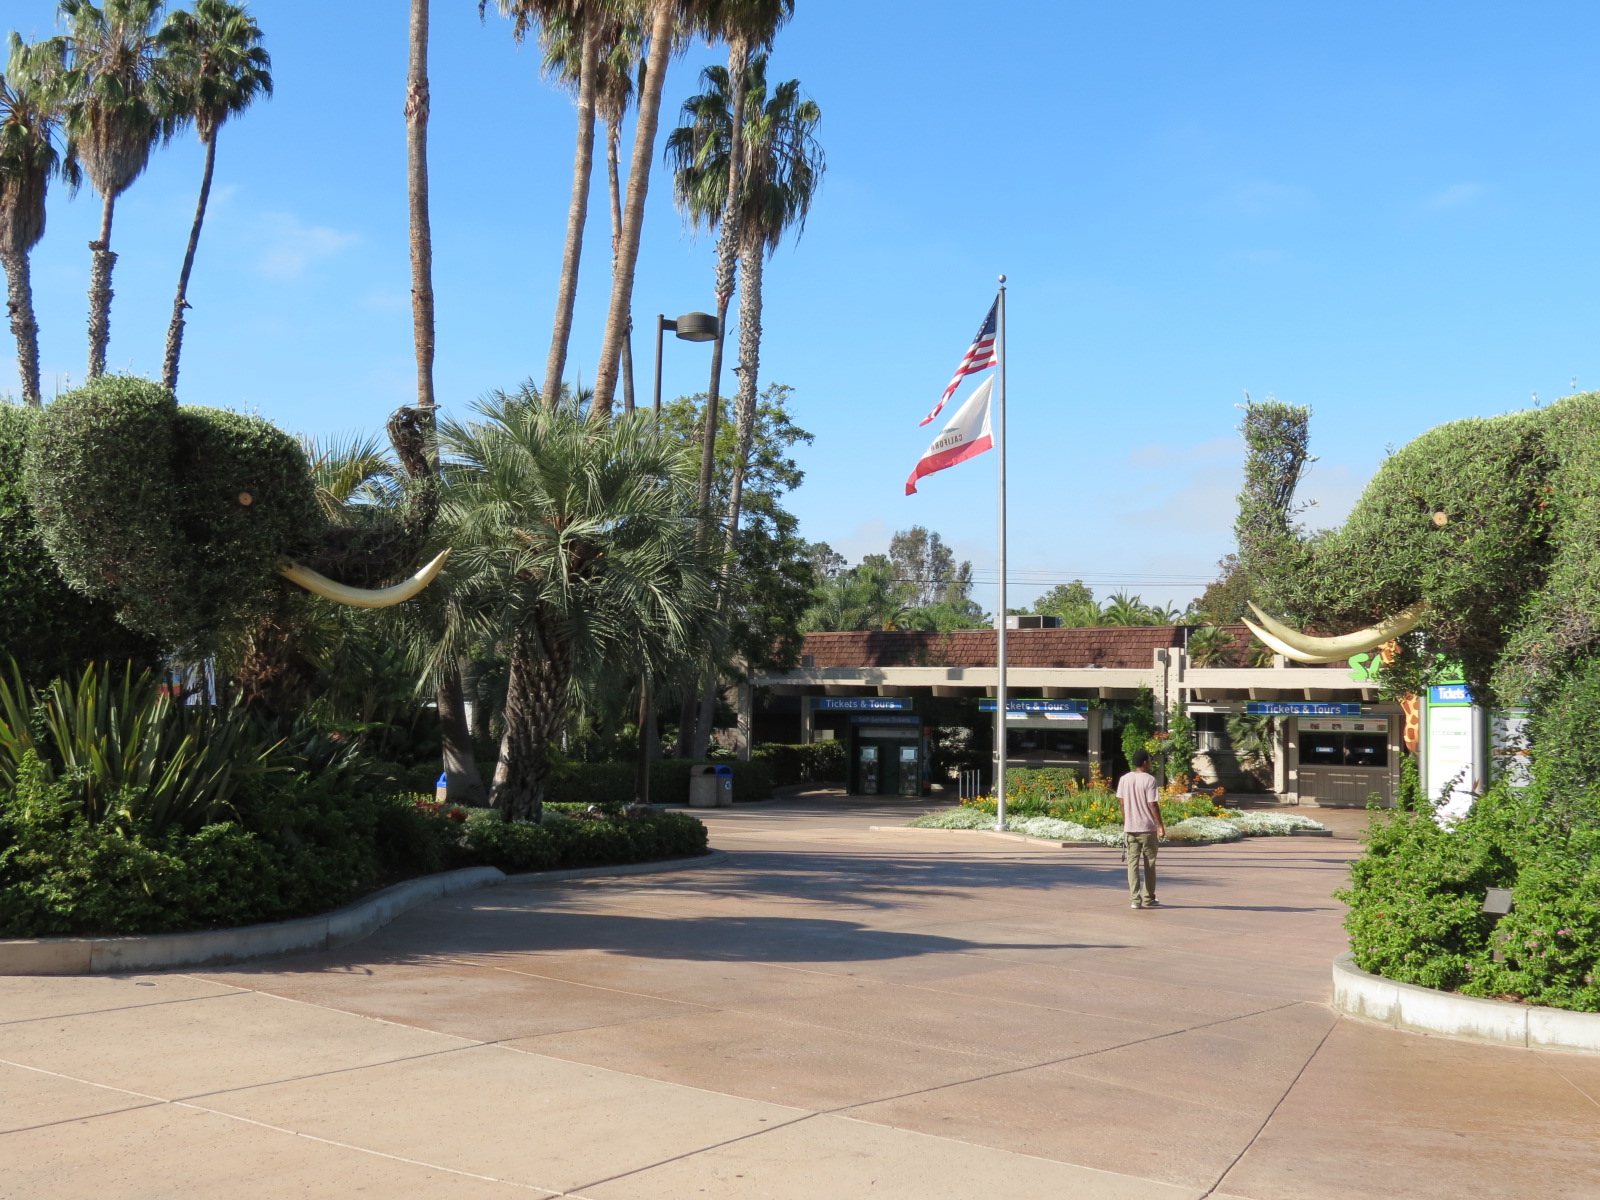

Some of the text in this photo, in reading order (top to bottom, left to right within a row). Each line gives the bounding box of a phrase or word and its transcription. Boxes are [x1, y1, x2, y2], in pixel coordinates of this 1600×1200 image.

[1438, 687, 1465, 700] Tickets
[825, 699, 895, 708] Tickets & Tours
[1005, 701, 1070, 711] ckets & Tours
[1264, 704, 1341, 714] Tickets & Tours
